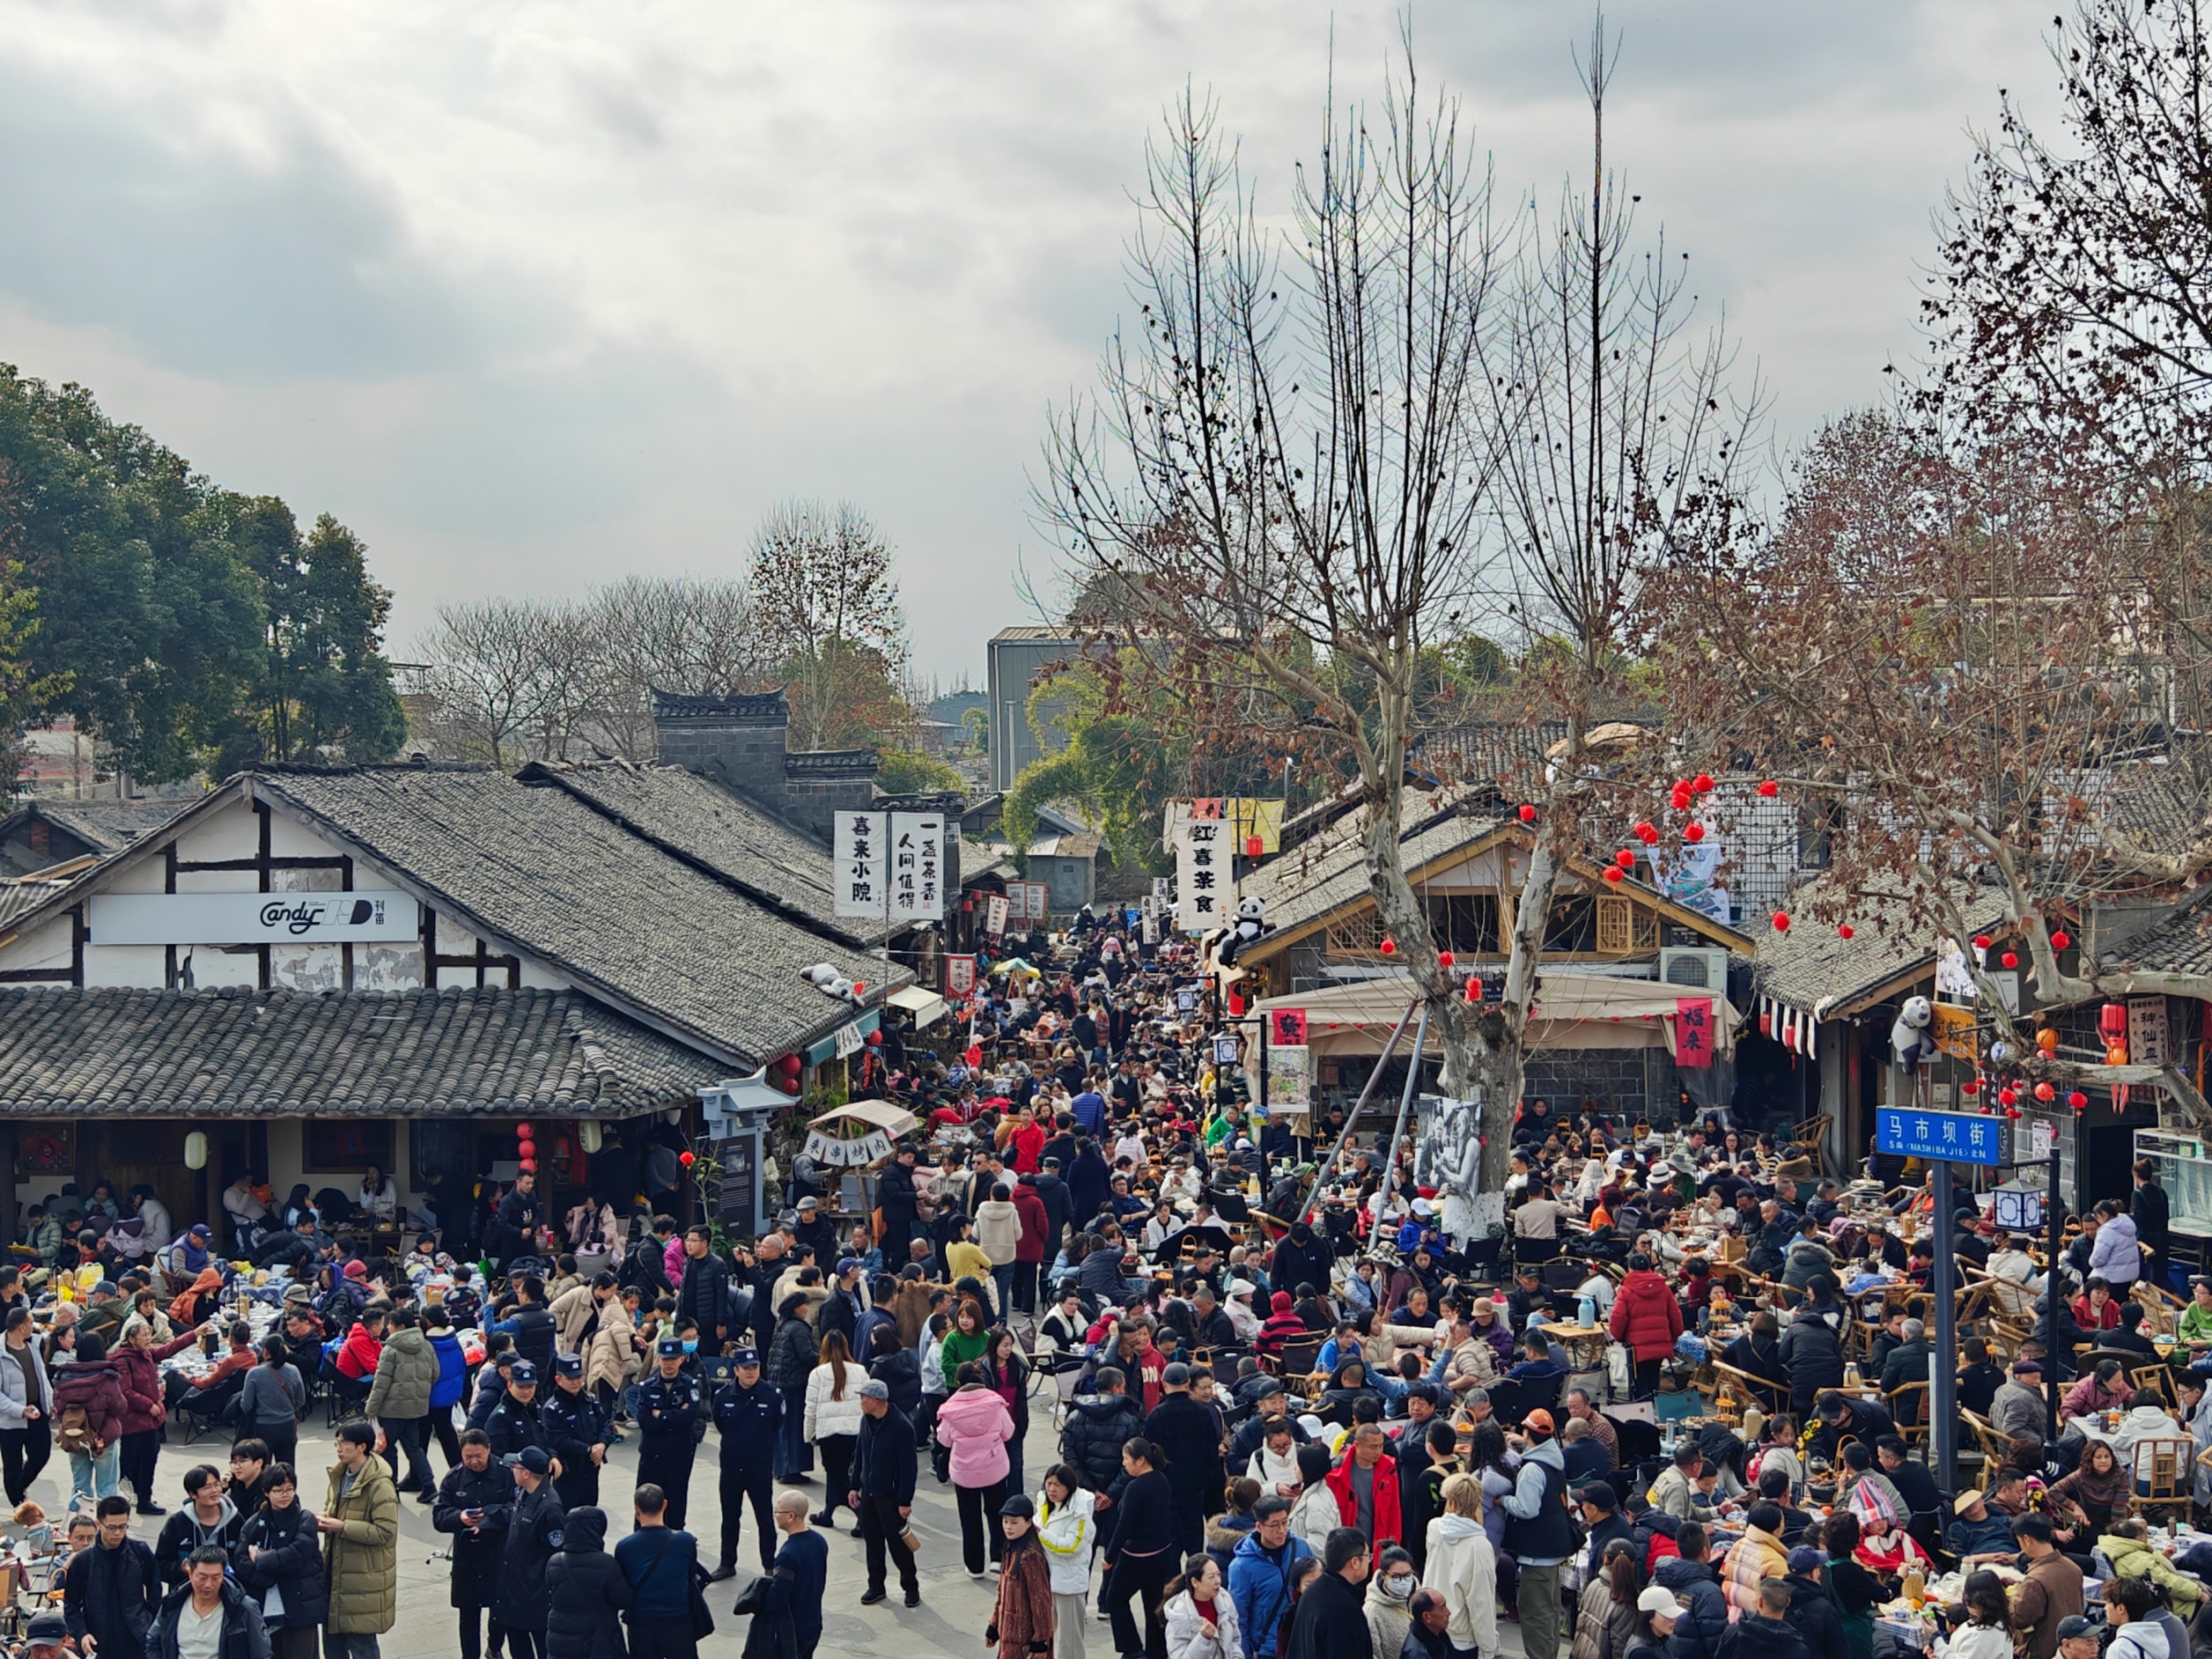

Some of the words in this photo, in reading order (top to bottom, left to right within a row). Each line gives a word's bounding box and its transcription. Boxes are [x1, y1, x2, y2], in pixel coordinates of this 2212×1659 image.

[851, 816, 872, 902] 喜来小院
[897, 833, 915, 910] 人间值得
[920, 823, 937, 901] 一盏茶香
[260, 901, 325, 934] Candy
[375, 900, 385, 925] 刊笛
[1889, 1115, 1985, 1147] 马市坝街
